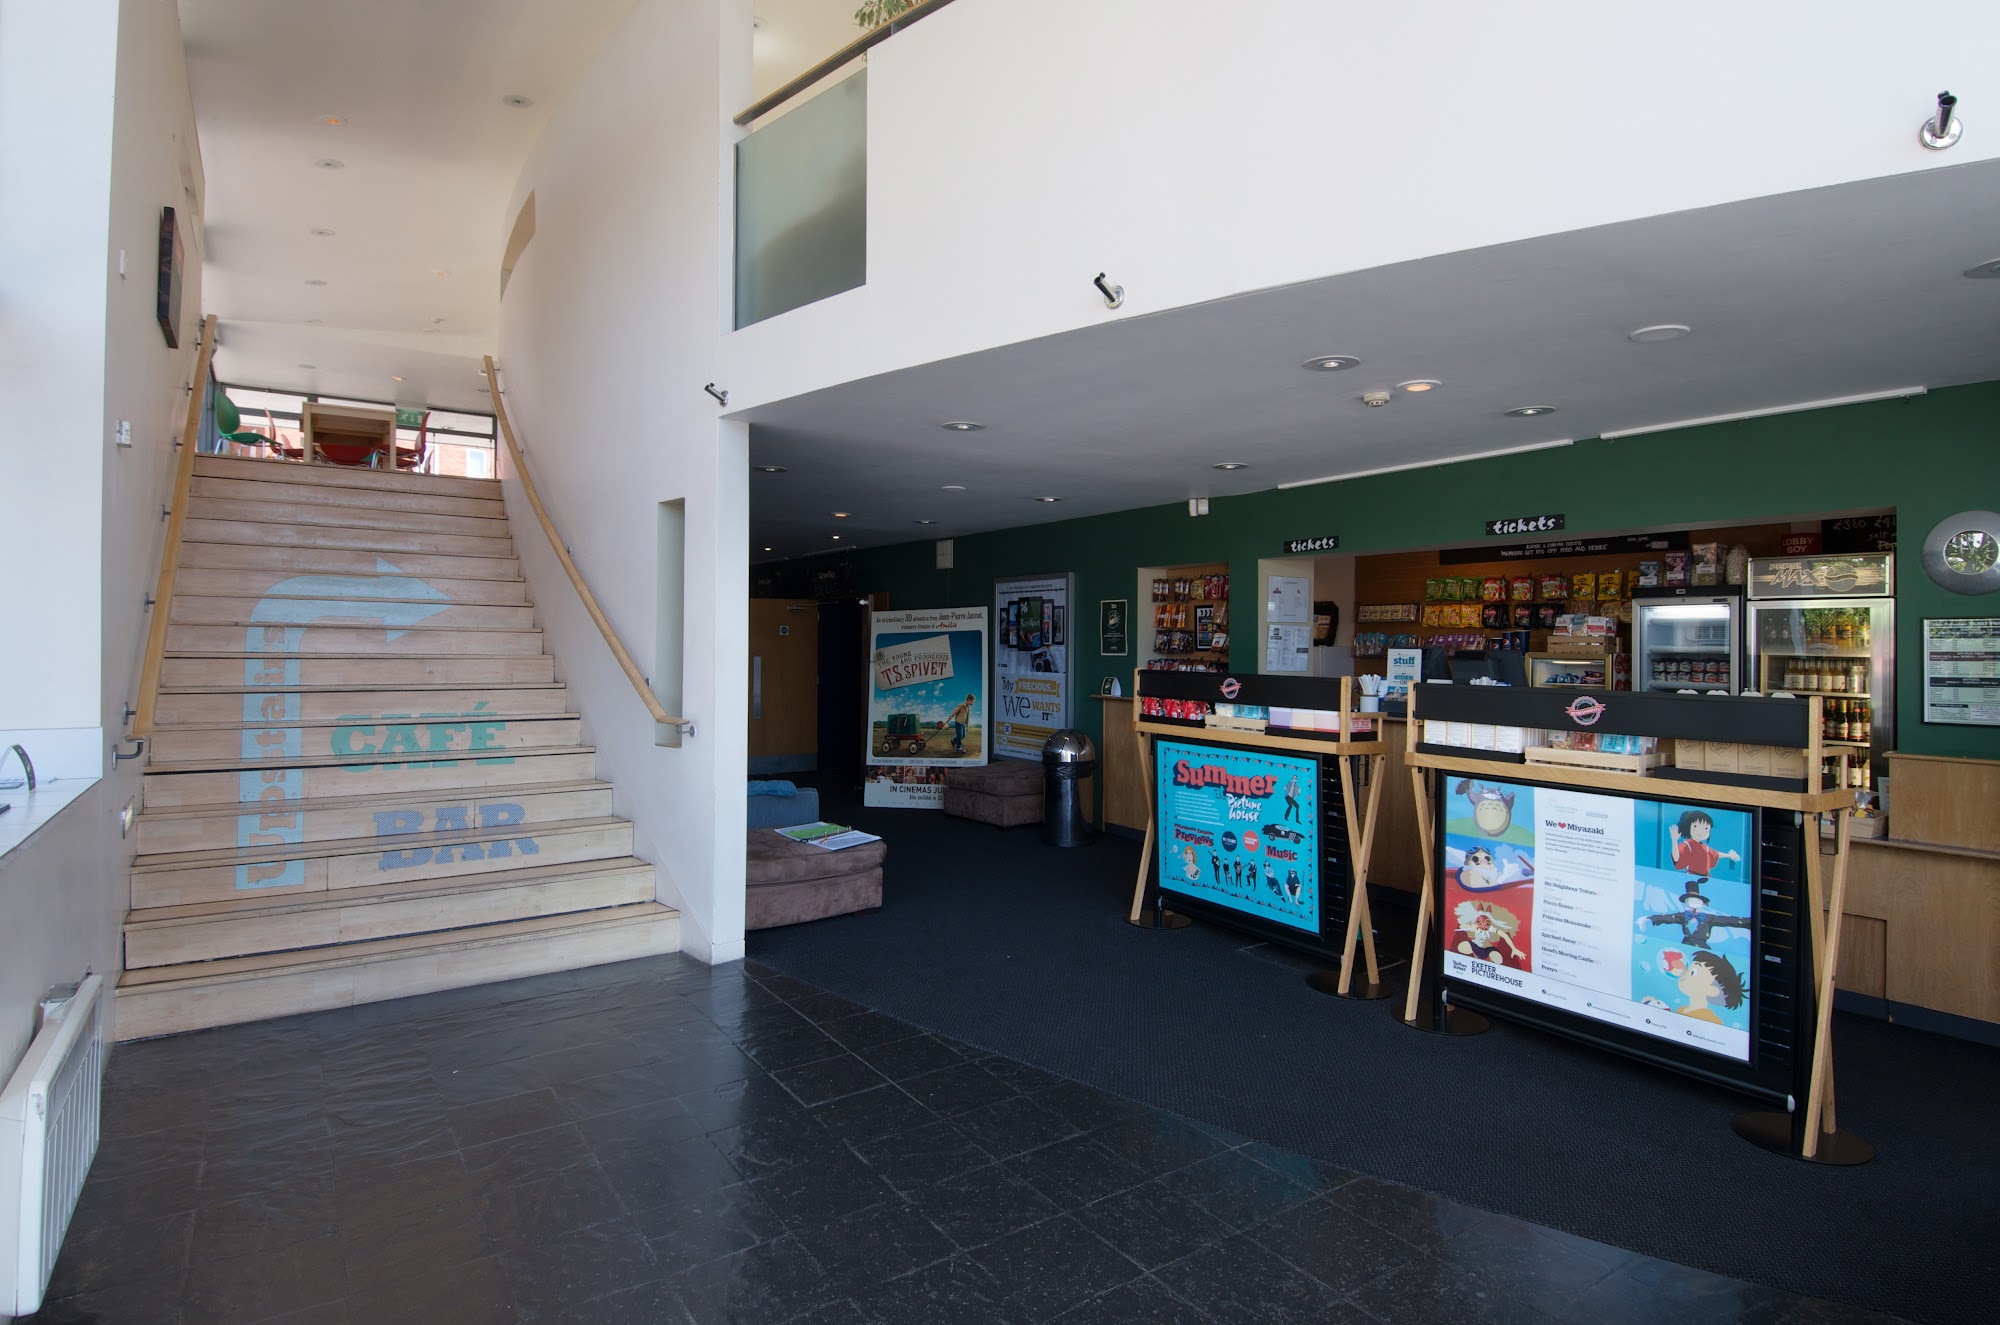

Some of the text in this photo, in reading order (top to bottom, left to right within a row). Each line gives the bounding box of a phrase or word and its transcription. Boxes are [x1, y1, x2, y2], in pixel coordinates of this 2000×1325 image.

[1493, 517, 1556, 534] tickets
[1291, 537, 1334, 553] tickets
[1782, 536, 1813, 547] LOBBY
[1787, 545, 1807, 554] BOY
[1770, 569, 1820, 589] MAX
[905, 613, 912, 622] 3D
[878, 651, 912, 668] THE YOUNG
[901, 653, 949, 665] AND PRODIGIOUS
[1393, 656, 1415, 665] stuff
[904, 661, 948, 680] SPIVET
[1003, 696, 1061, 719] We WANTS
[330, 701, 515, 773] CAFÉ
[247, 625, 297, 885] Upstairs
[1174, 759, 1278, 798] Summer
[900, 786, 932, 794] CINEMAS
[1226, 793, 1262, 812] Picture
[1545, 820, 1604, 835] We Miyazaki
[373, 802, 540, 871] BAR
[1174, 829, 1214, 847] Previews
[1266, 845, 1298, 862] Music
[1552, 882, 1578, 892] Neighbour
[1578, 887, 1597, 896] Totoro
[1542, 914, 1563, 923] Princess
[1541, 932, 1562, 941] Spirited
[1562, 937, 1576, 945] Away
[1558, 950, 1578, 960] Moving
[1577, 955, 1594, 964] Castle
[1471, 961, 1497, 973] EXETER
[1541, 964, 1558, 973] Ponyo
[1471, 968, 1523, 988] PICTUREHOUSE
